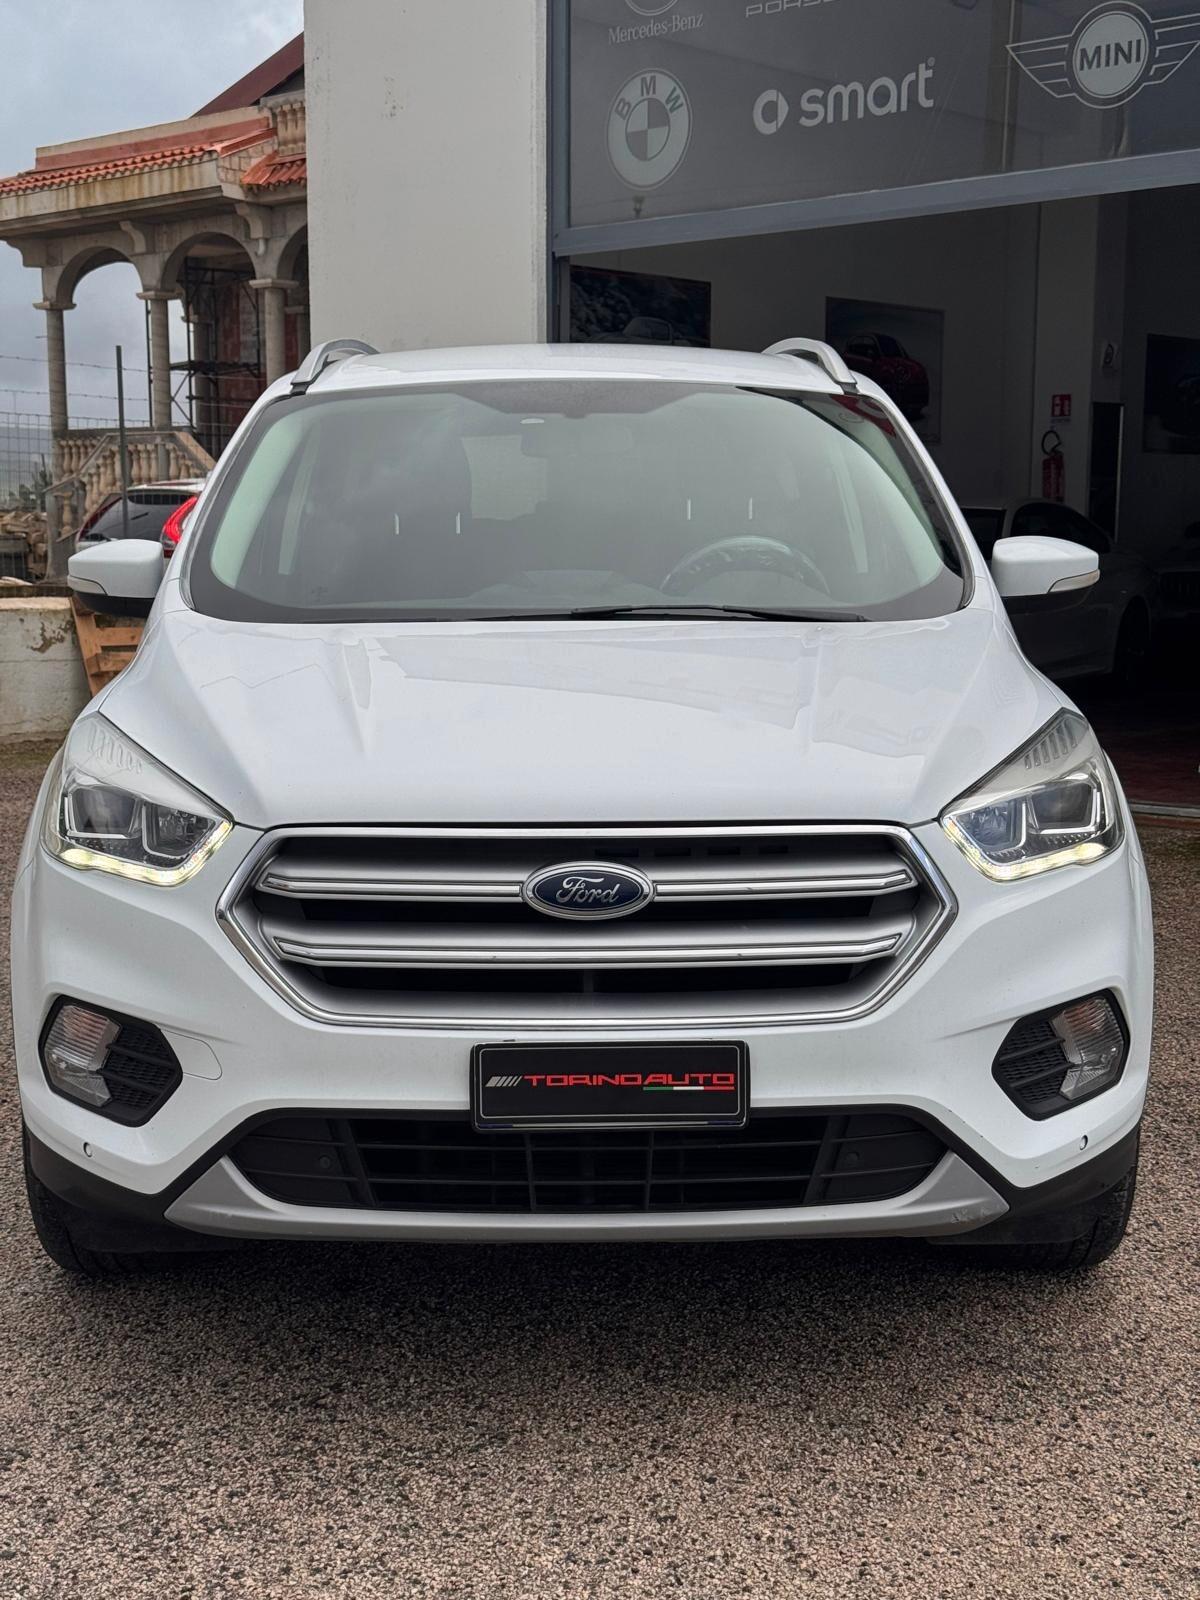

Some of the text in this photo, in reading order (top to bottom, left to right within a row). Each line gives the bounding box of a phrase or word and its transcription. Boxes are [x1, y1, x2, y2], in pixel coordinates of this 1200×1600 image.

[608, 13, 704, 45] Mercedes-Benz
[1079, 38, 1142, 71] MINI
[614, 75, 684, 120] BMW
[799, 63, 934, 127] smart
[555, 876, 621, 903] Ford
